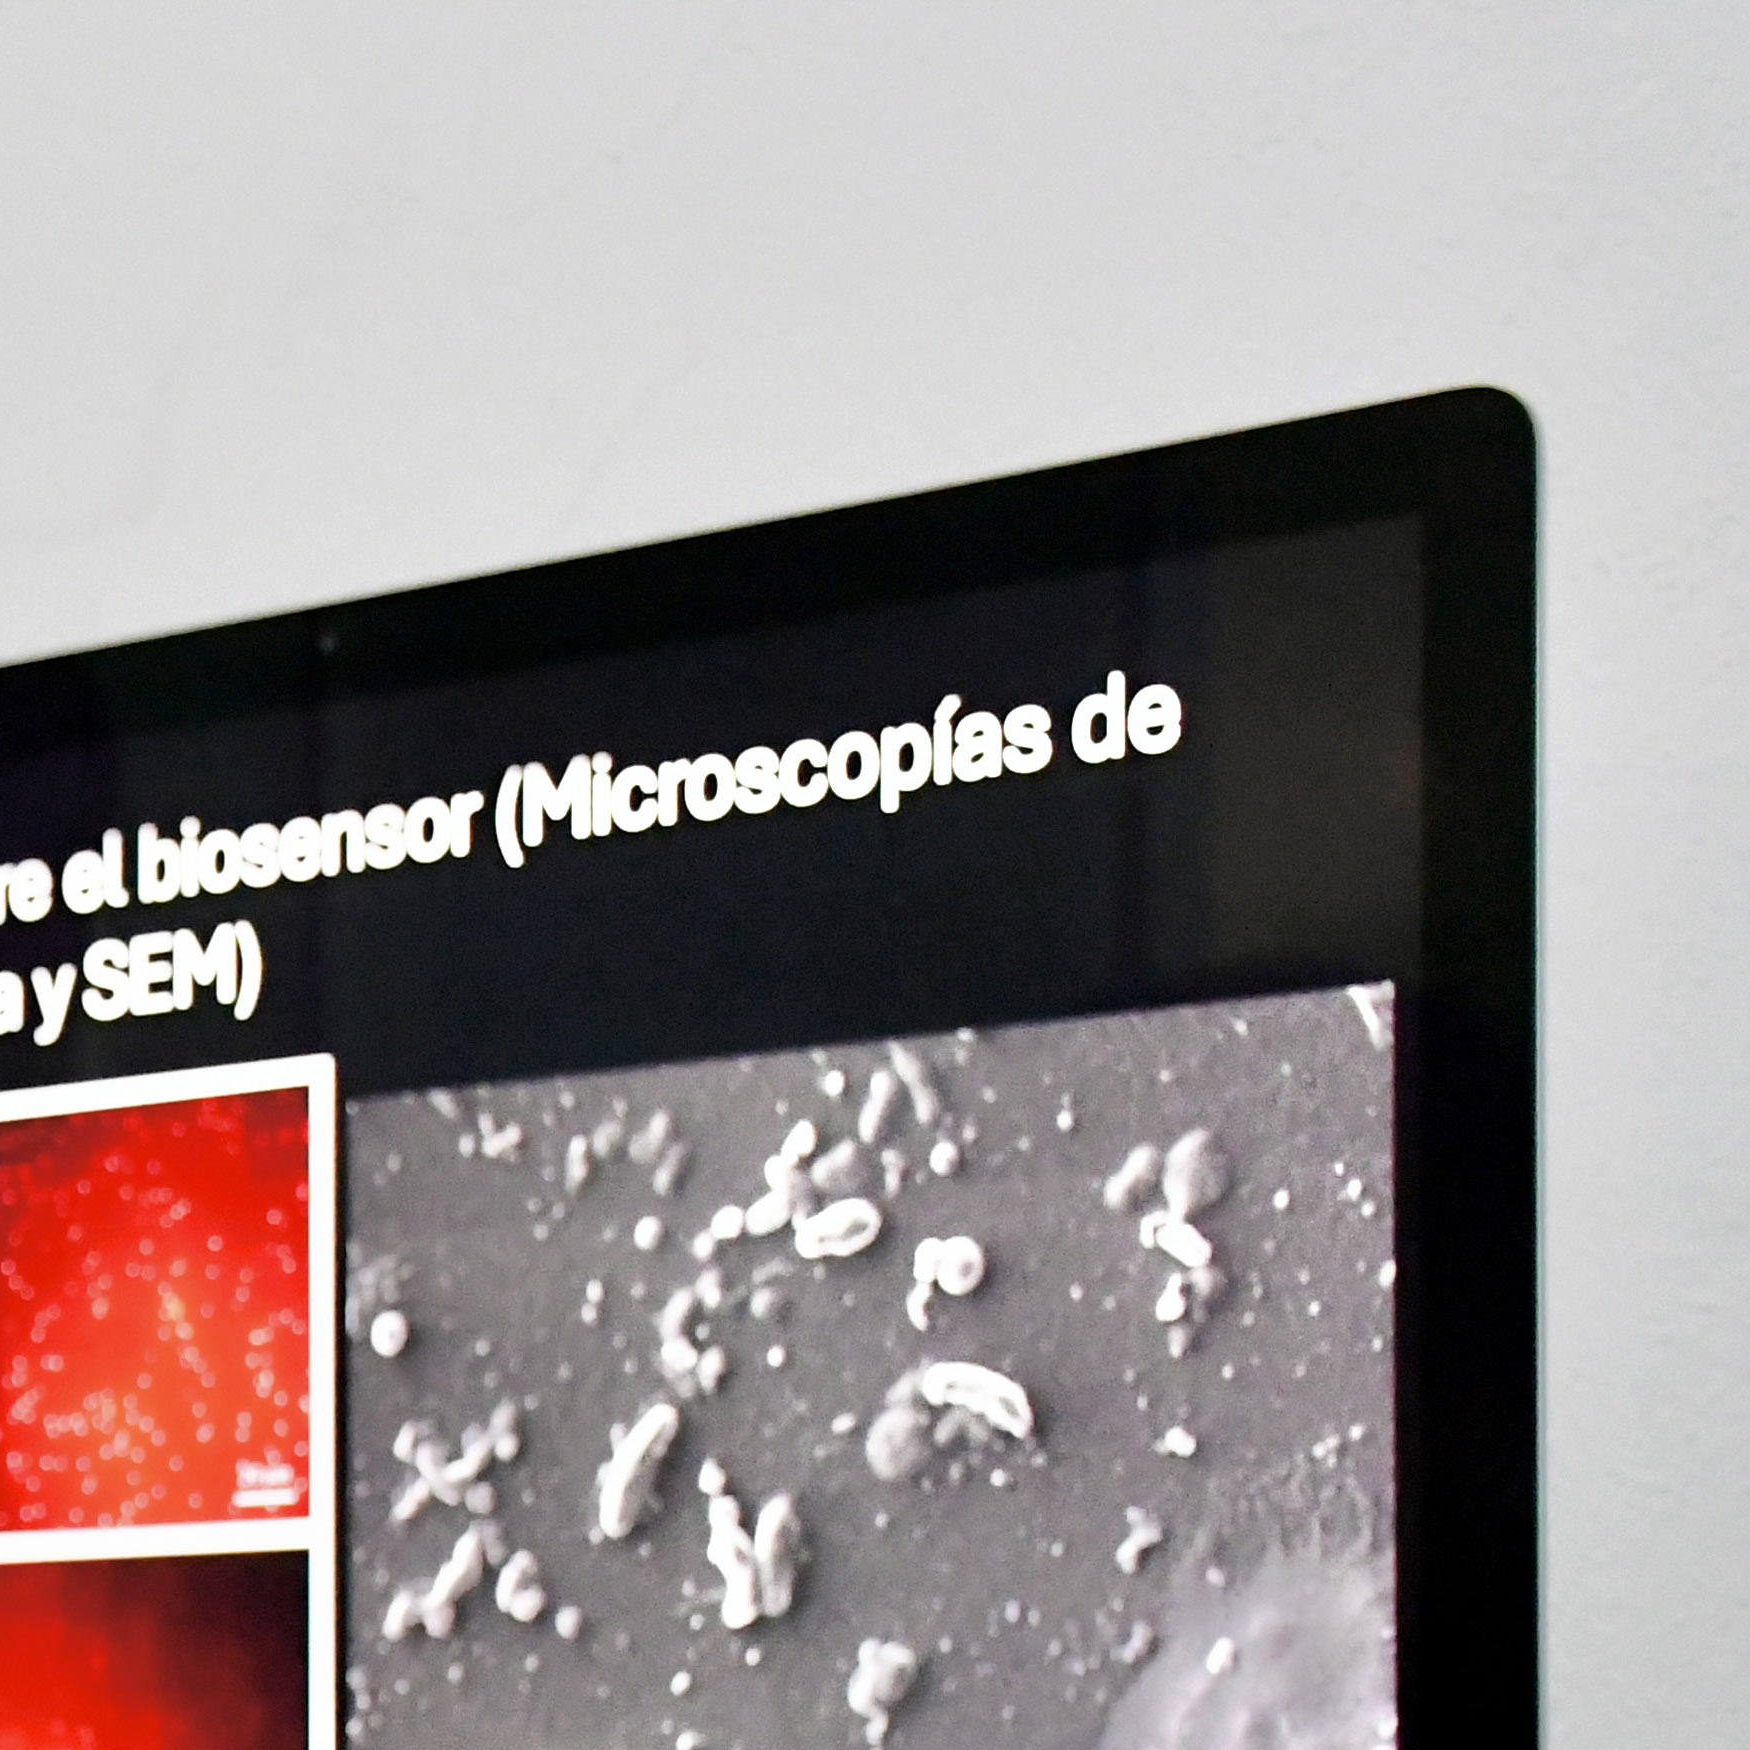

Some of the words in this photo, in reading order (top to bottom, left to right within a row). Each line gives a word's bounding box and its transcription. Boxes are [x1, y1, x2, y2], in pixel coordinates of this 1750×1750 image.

[62, 828, 129, 914] el
[138, 790, 484, 904] biosensor
[495, 694, 1053, 868] (Microscopías
[1071, 670, 1182, 763] de
[31, 963, 77, 1046] y
[82, 920, 263, 1021] SEM)
